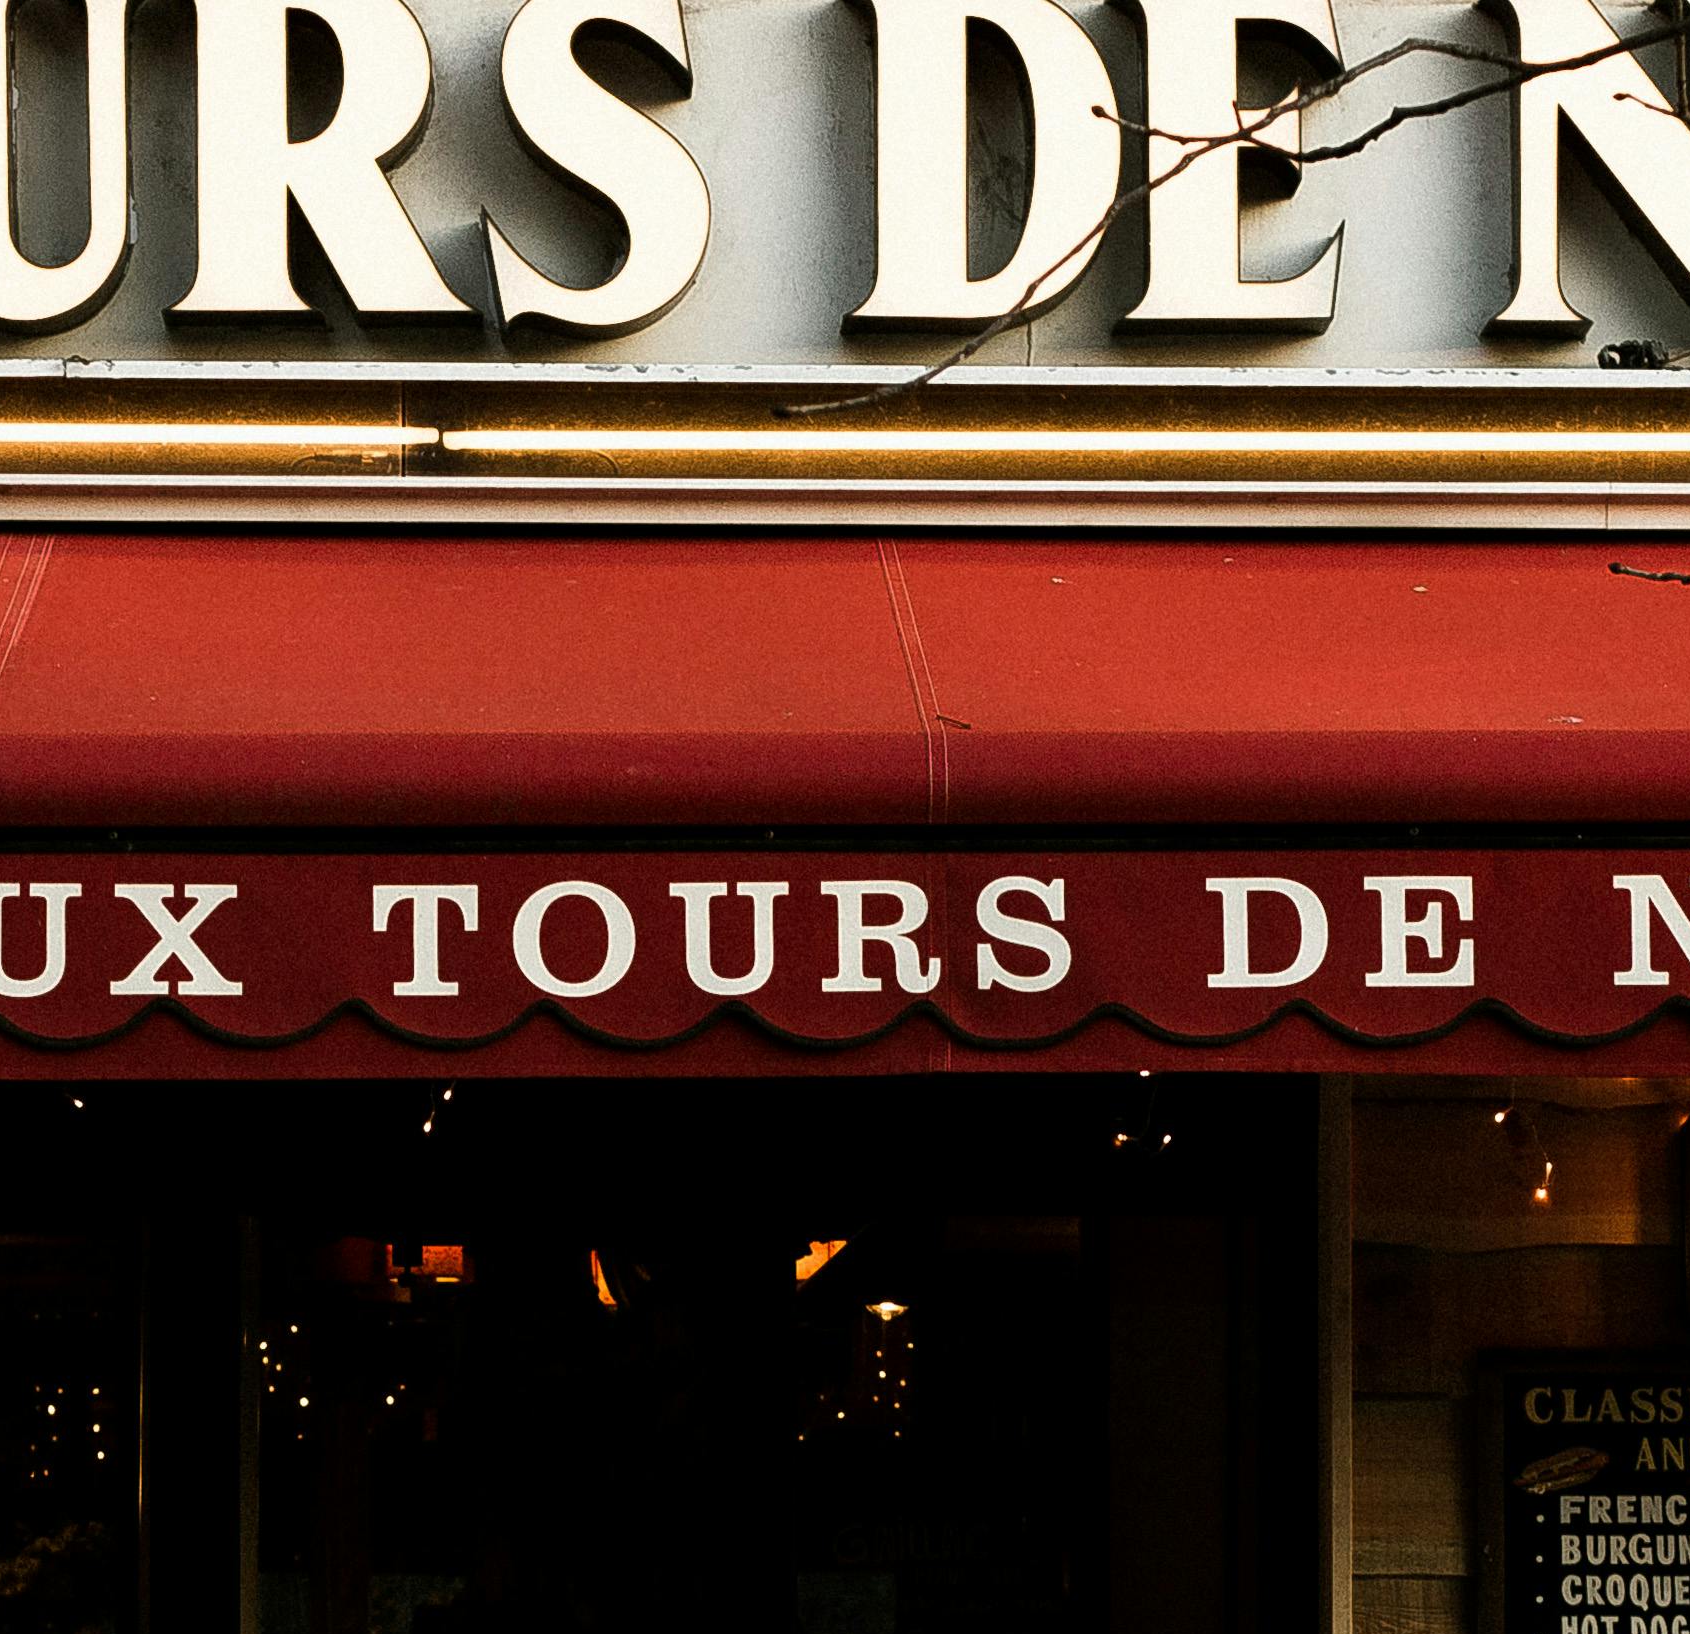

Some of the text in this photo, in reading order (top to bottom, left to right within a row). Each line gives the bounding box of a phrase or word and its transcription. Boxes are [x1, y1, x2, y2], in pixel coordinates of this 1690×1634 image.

[845, 0, 1344, 334] DE
[372, 875, 1072, 995] TOURS
[1205, 875, 1475, 989] DE
